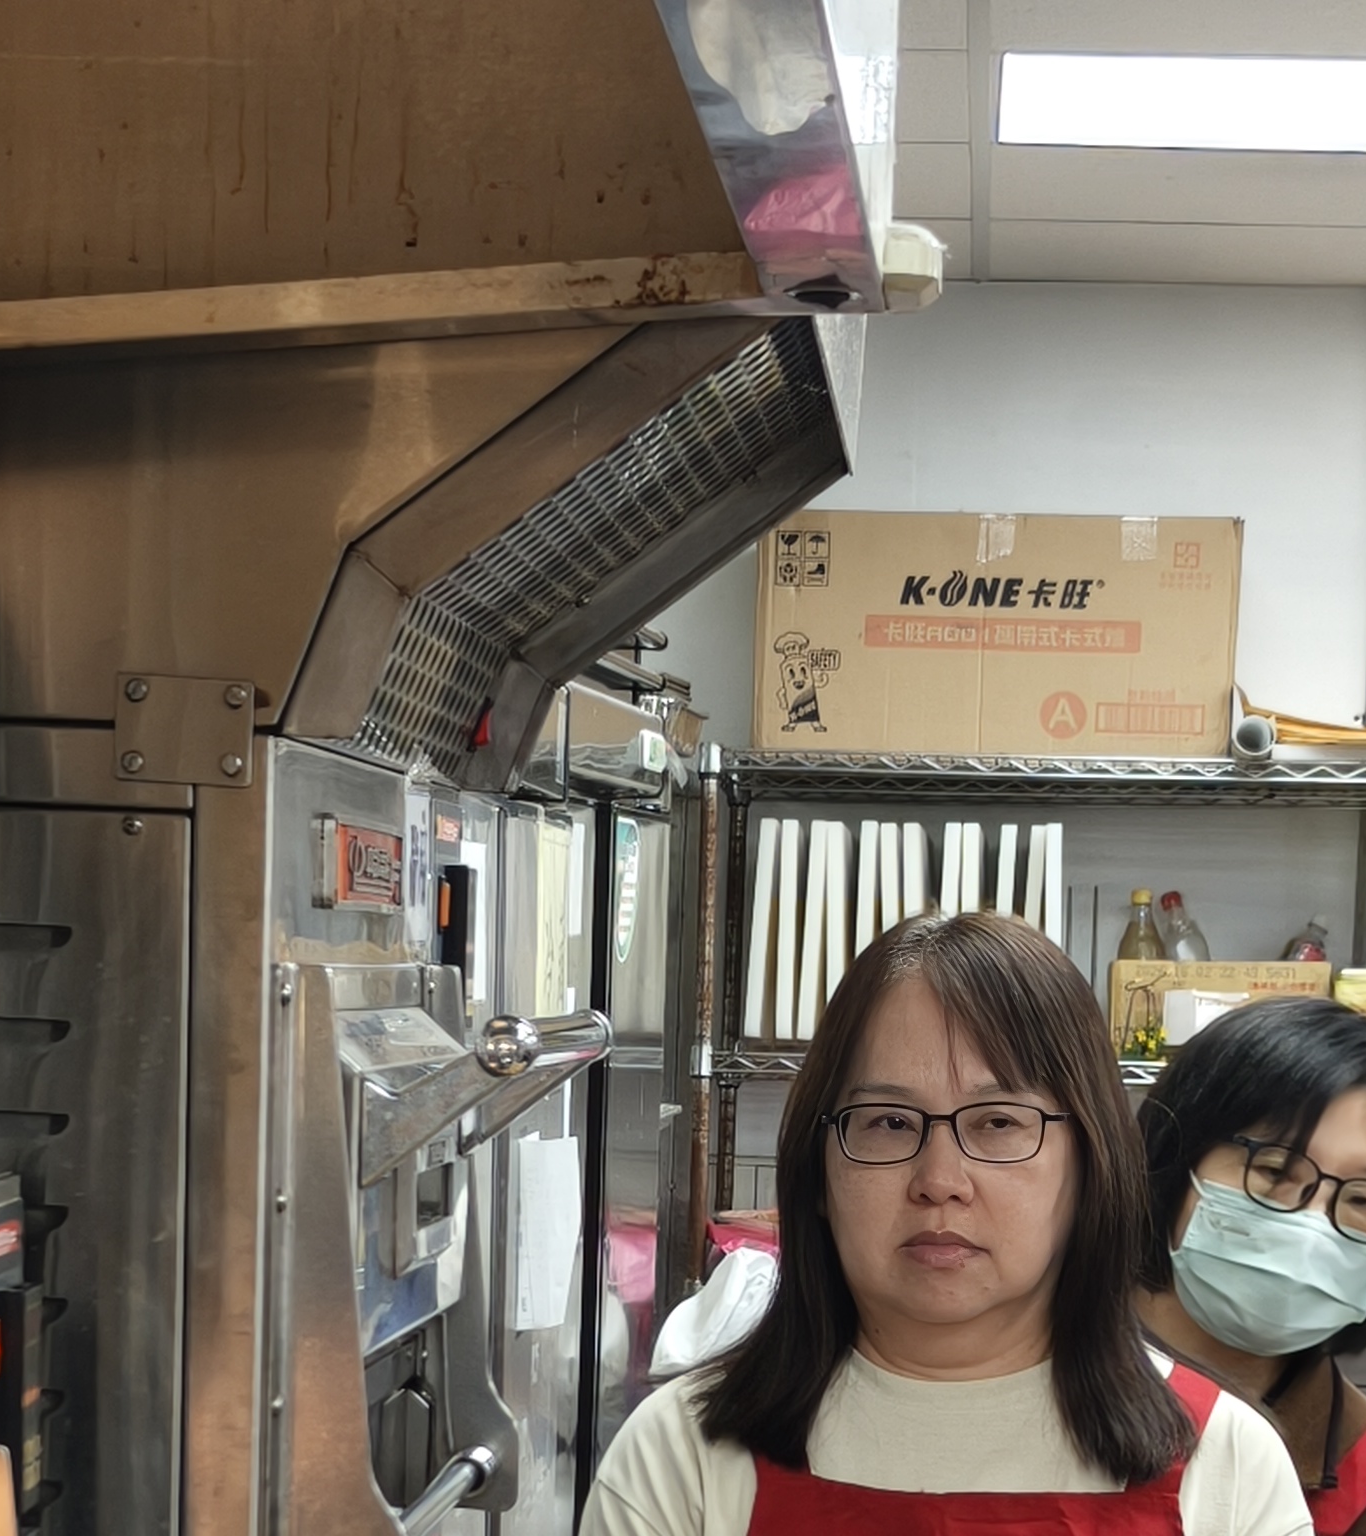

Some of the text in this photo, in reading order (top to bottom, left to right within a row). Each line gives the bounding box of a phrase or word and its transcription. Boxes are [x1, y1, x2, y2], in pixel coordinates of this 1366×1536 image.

[900, 570, 1094, 610] K-ONE 卡旺
[810, 651, 839, 669] SAFETY
